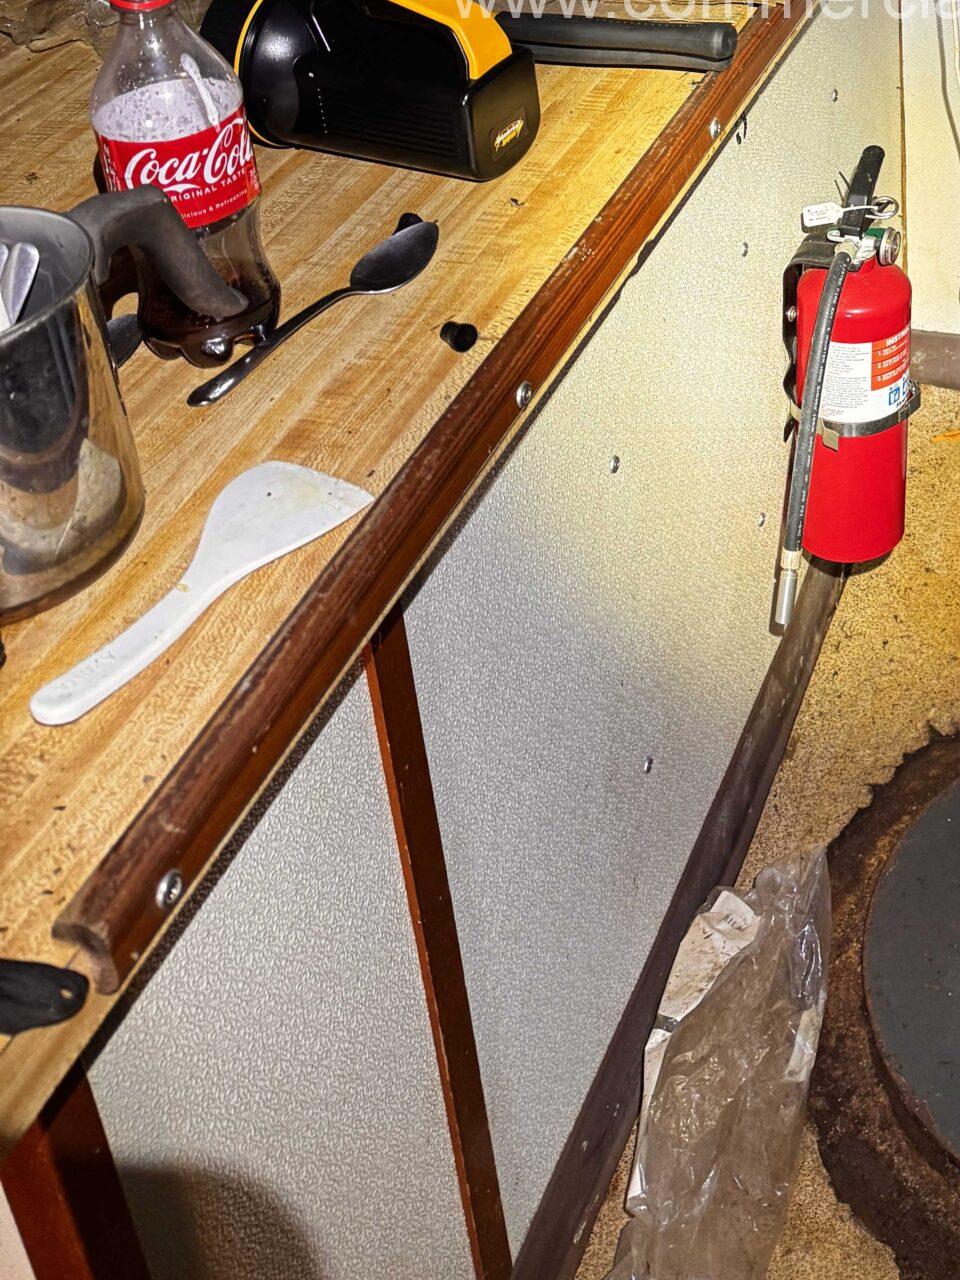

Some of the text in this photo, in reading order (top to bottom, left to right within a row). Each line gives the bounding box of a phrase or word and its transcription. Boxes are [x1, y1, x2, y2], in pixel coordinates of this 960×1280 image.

[171, 186, 218, 203] RIGINAL
[221, 168, 246, 187] TASTE
[181, 209, 207, 219] licious
[215, 189, 248, 209] Refreshing
